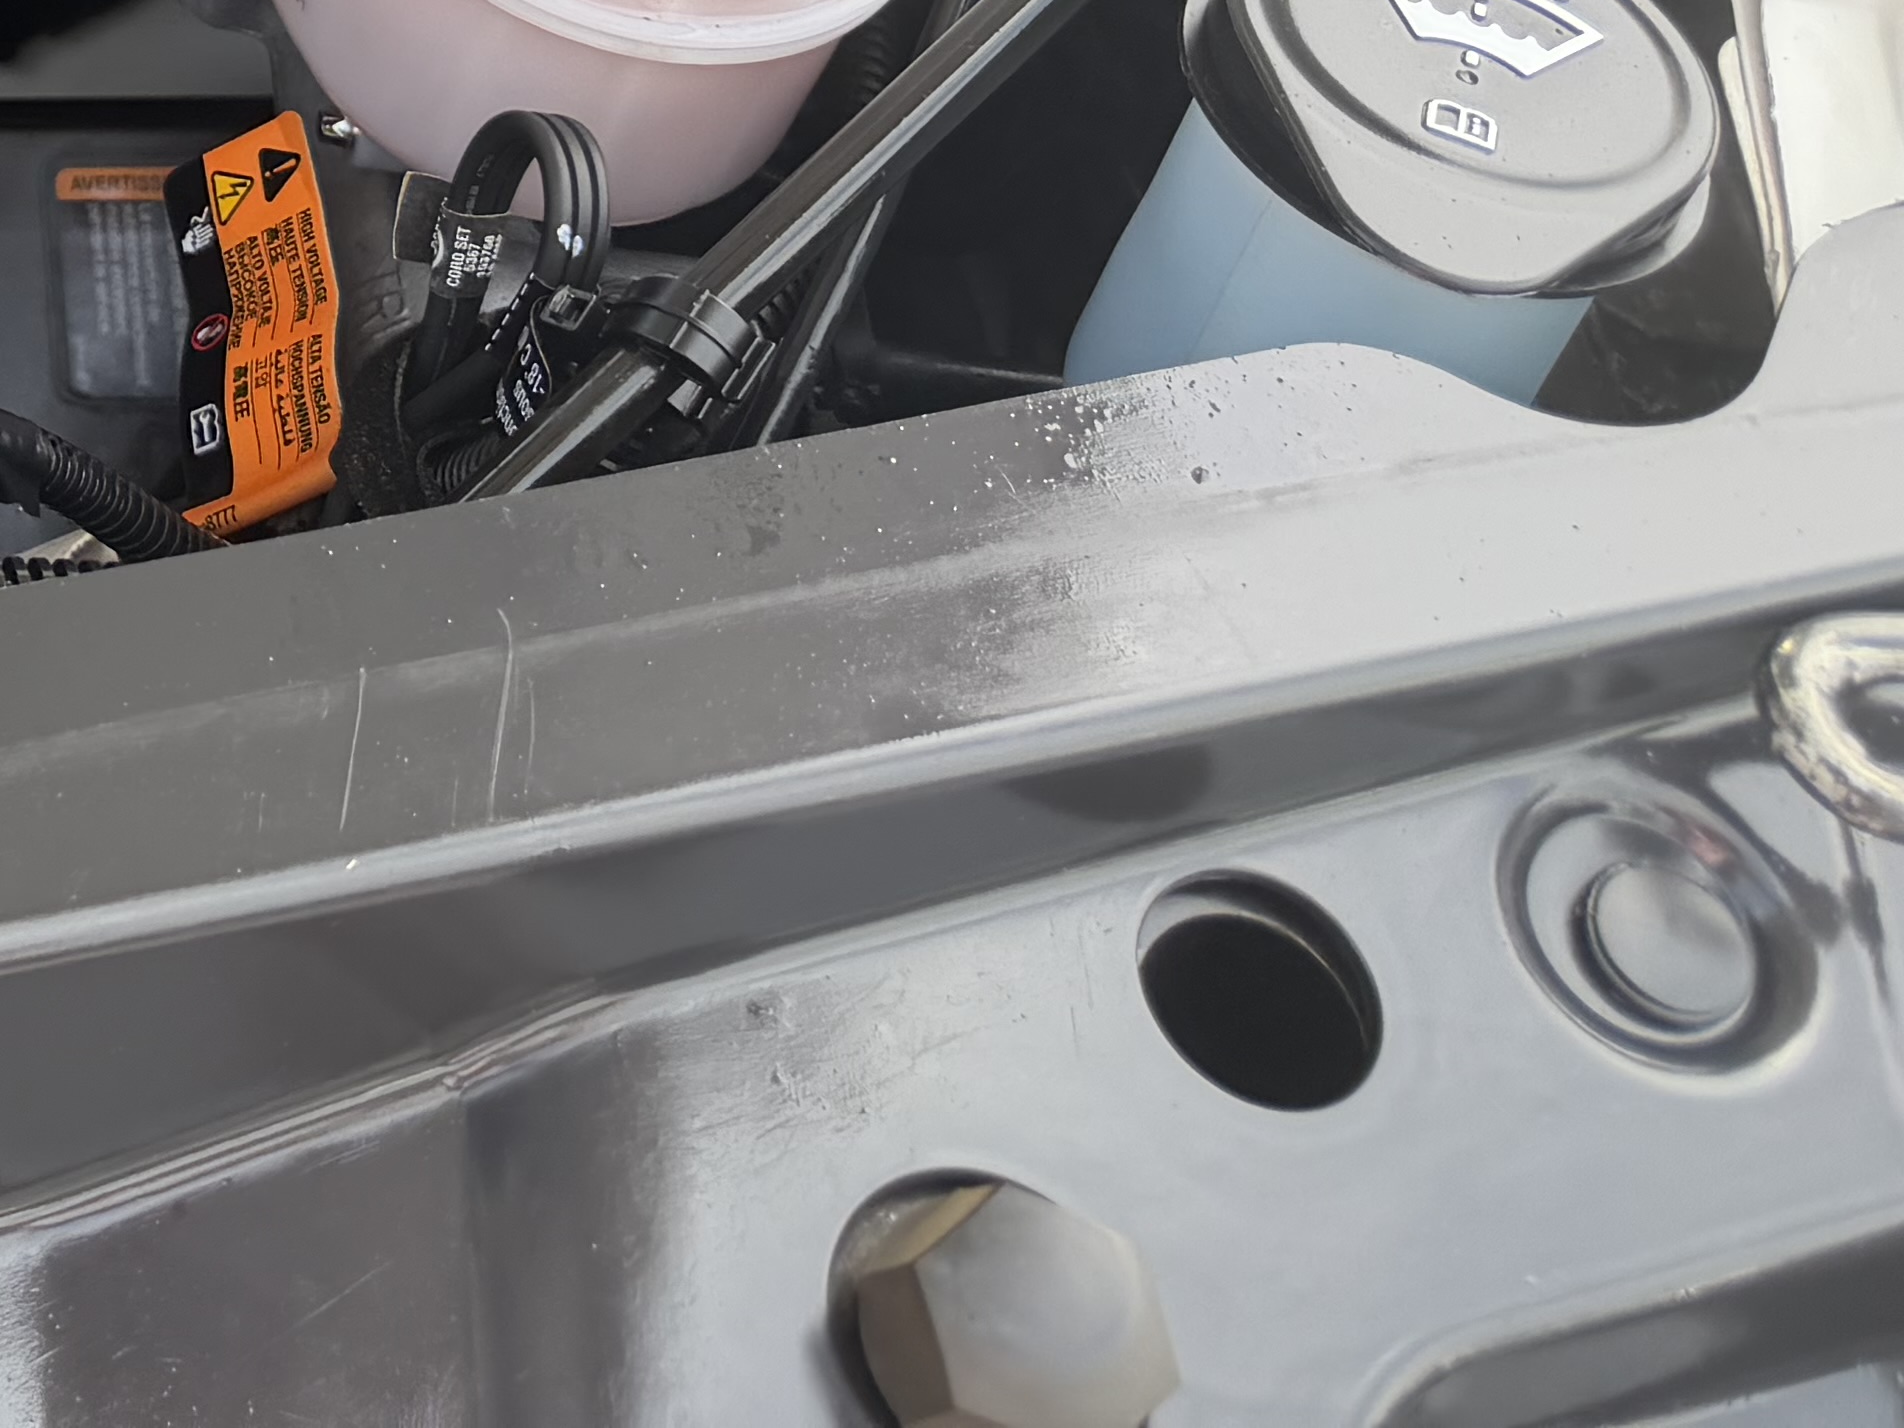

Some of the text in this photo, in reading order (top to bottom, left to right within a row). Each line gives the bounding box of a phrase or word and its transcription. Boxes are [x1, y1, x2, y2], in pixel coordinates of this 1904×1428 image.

[71, 174, 165, 192] AVERTISS
[234, 241, 258, 322] ВЫСОКОЕ
[246, 235, 274, 328] ALTO VOLTAJE
[281, 216, 309, 322] HAUTE TENSION
[299, 208, 328, 306] HIGH VOLTAGE
[454, 225, 472, 252] SET
[292, 339, 313, 454] HOCHSPANNUNG
[308, 333, 332, 425] ALTA TENSÃO
